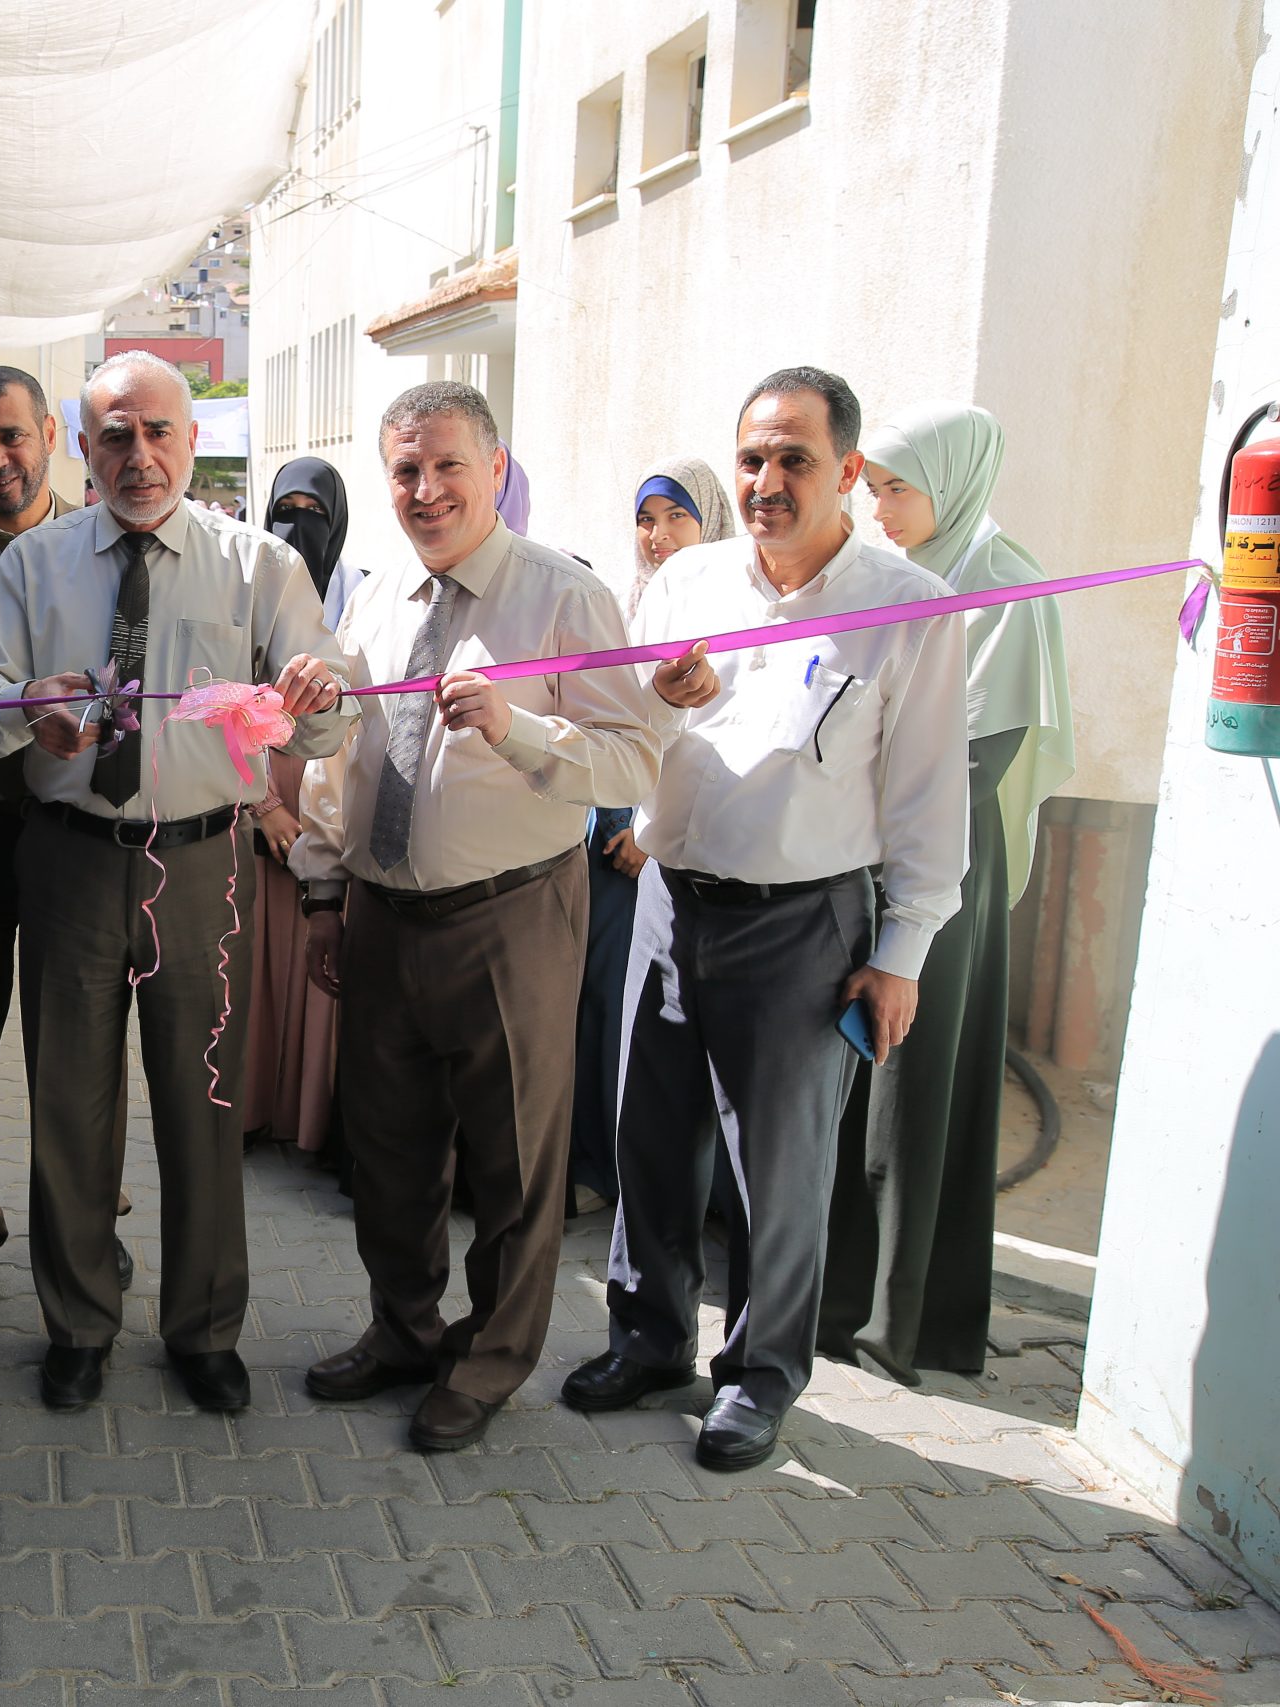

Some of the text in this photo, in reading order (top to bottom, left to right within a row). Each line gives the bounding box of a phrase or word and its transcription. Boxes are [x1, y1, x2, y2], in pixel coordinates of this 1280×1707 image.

[1231, 517, 1277, 526] HALON 1211
[1238, 536, 1275, 553] شركة
